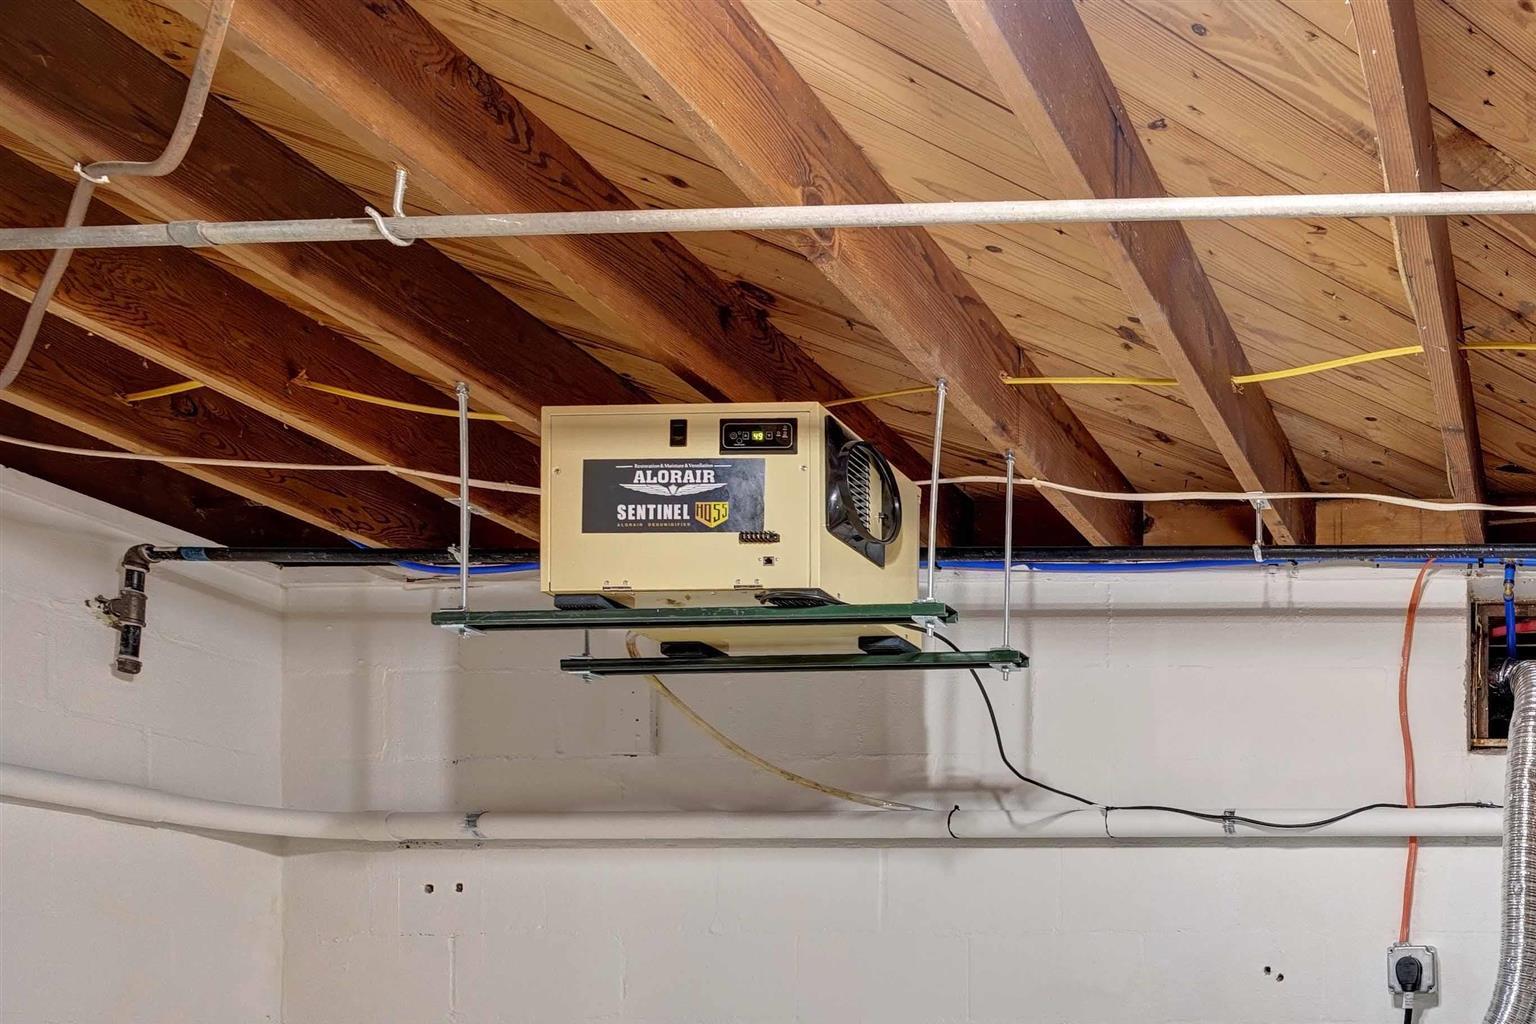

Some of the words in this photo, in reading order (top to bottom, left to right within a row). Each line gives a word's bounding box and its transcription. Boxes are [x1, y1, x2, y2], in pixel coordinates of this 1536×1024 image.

[752, 431, 763, 440] 49
[633, 470, 715, 483] ALORAIR
[617, 504, 690, 520] SENTINEL
